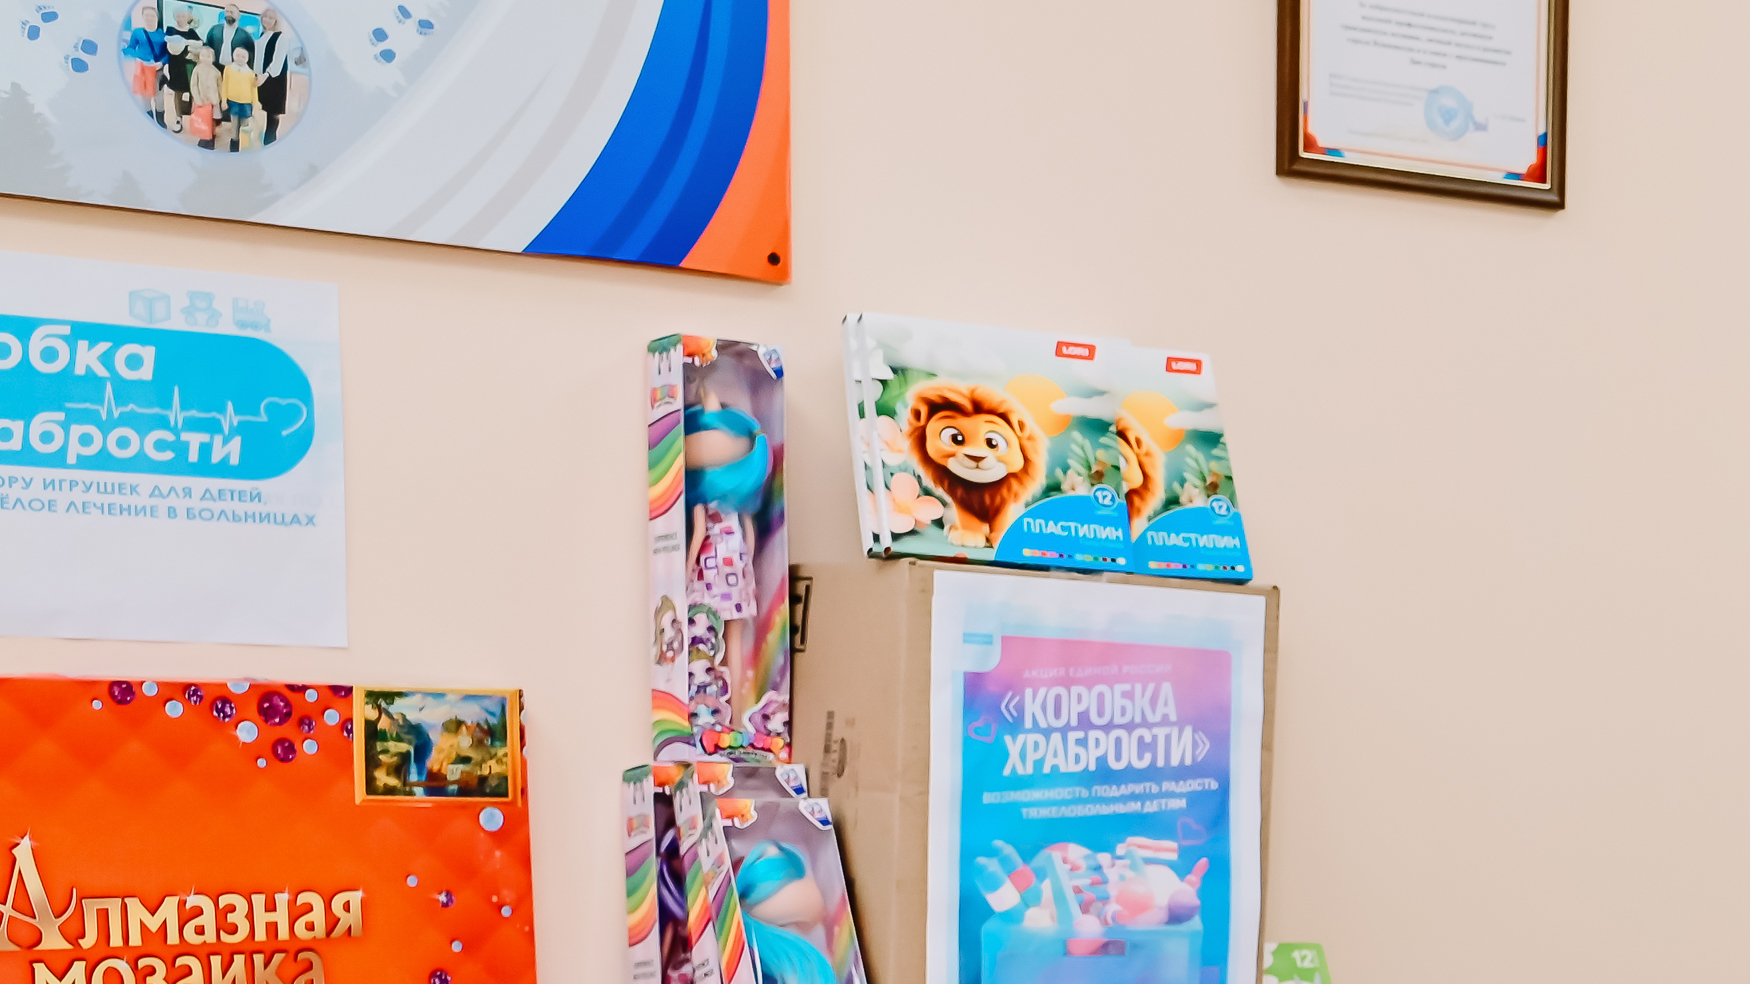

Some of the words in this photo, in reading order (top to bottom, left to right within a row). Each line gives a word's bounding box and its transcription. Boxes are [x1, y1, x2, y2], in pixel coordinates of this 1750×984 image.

[0, 411, 242, 466] абрости
[43, 478, 141, 496] ИГРУШЕК
[149, 484, 193, 500] ДЛЯ
[1096, 489, 1113, 505] 12
[66, 500, 159, 519] ЛЕЧЕНИЕ
[167, 505, 178, 520] В
[186, 507, 317, 527] БОЛЬНИЦАХ
[1212, 501, 1230, 516] 12
[1023, 517, 1124, 541] ПЛАСТИЛИН
[1147, 531, 1241, 549] ПЛАСТИЛИН
[1001, 682, 1177, 730] «КОРОБКА
[1003, 725, 1210, 776] ХРАБРОСТИ»
[1092, 783, 1159, 799] ПОДАРИТЬ
[1162, 778, 1219, 793] РАДОСТЬ
[0, 834, 363, 951] Алмазная
[1292, 950, 1314, 968] 12
